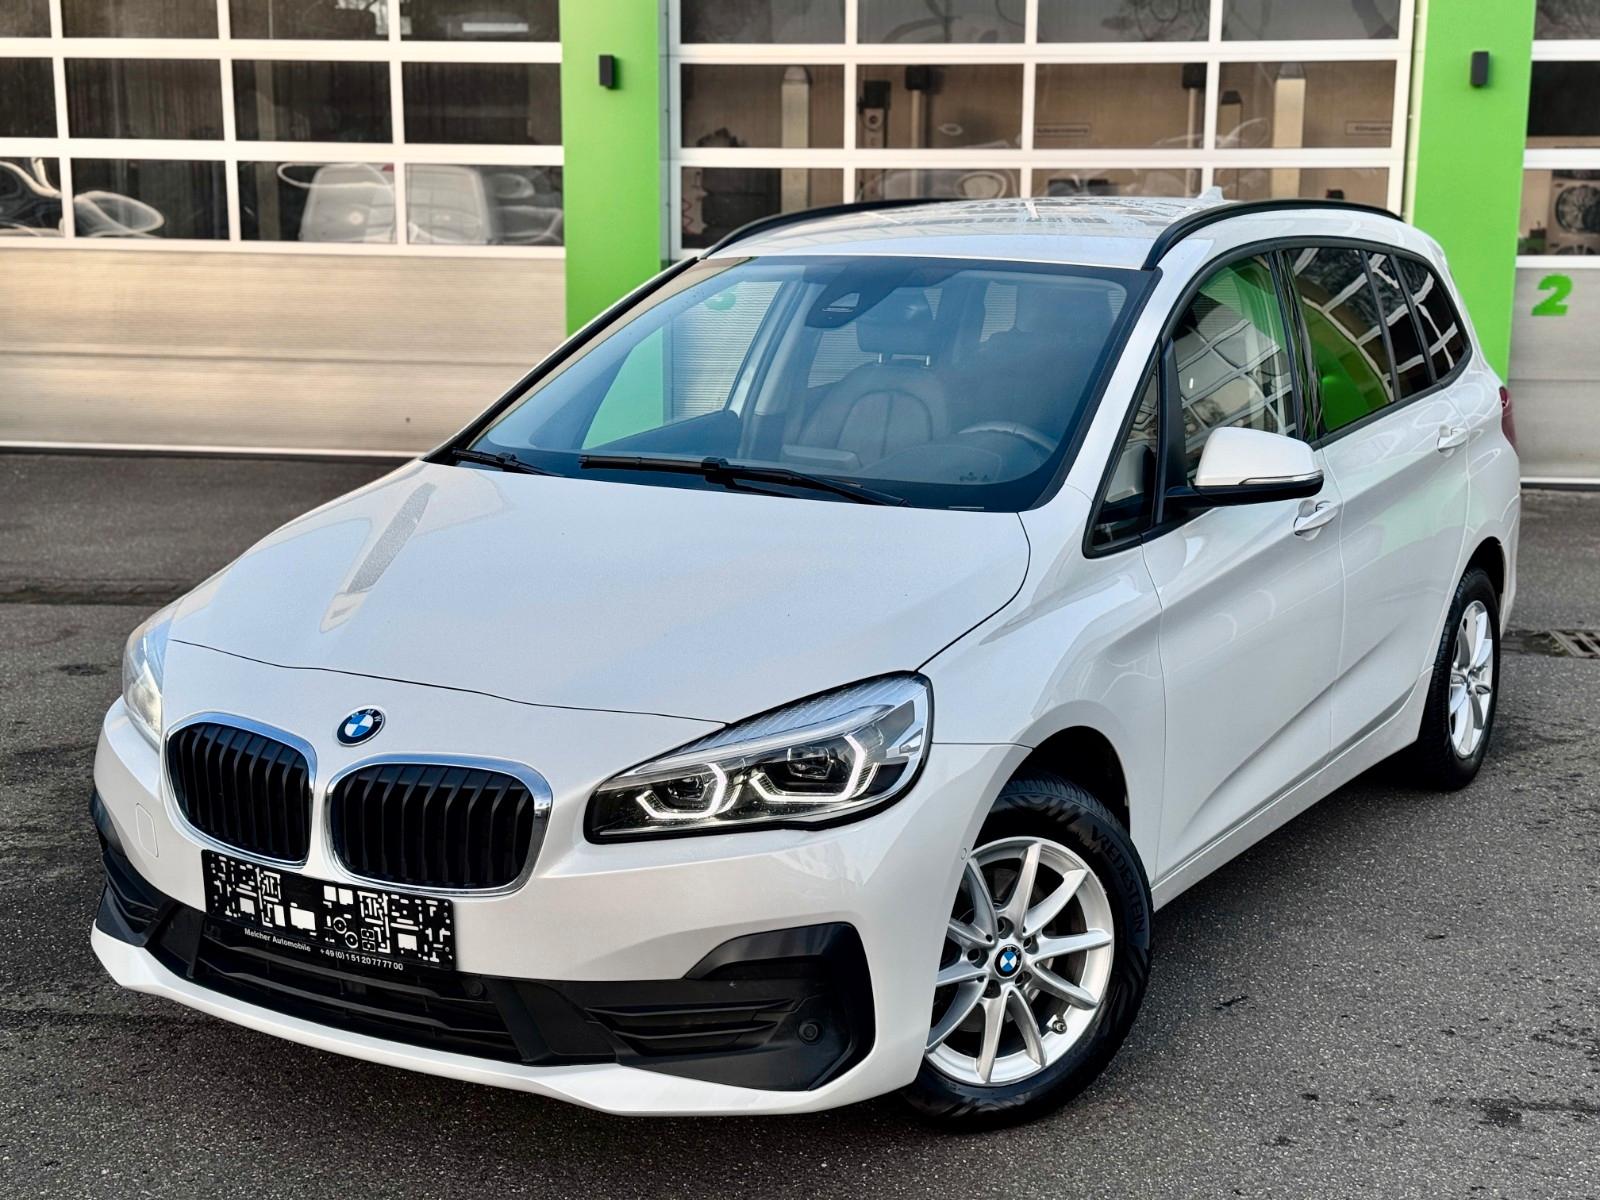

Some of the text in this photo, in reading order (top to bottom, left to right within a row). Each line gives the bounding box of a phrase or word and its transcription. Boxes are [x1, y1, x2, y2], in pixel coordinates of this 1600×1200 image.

[1531, 272, 1573, 316] 2
[1091, 824, 1146, 933] VREDESTEIN
[244, 927, 311, 952] Melcher Automobile
